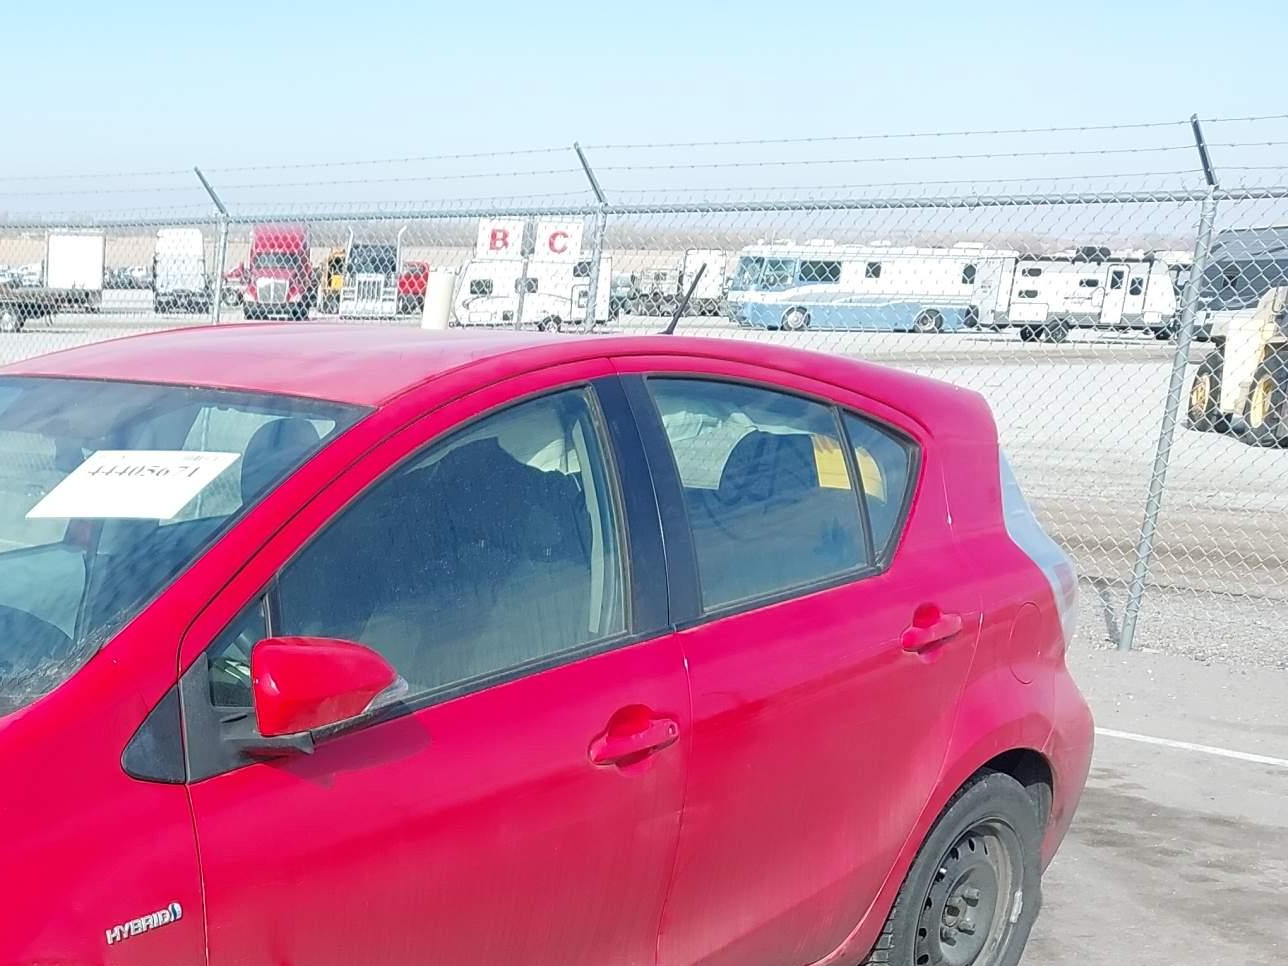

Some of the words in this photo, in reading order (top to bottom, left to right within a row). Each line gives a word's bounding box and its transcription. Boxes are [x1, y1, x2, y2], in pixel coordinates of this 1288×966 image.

[489, 228, 509, 251] B
[548, 231, 569, 253] C
[104, 908, 172, 945] HYBRID
